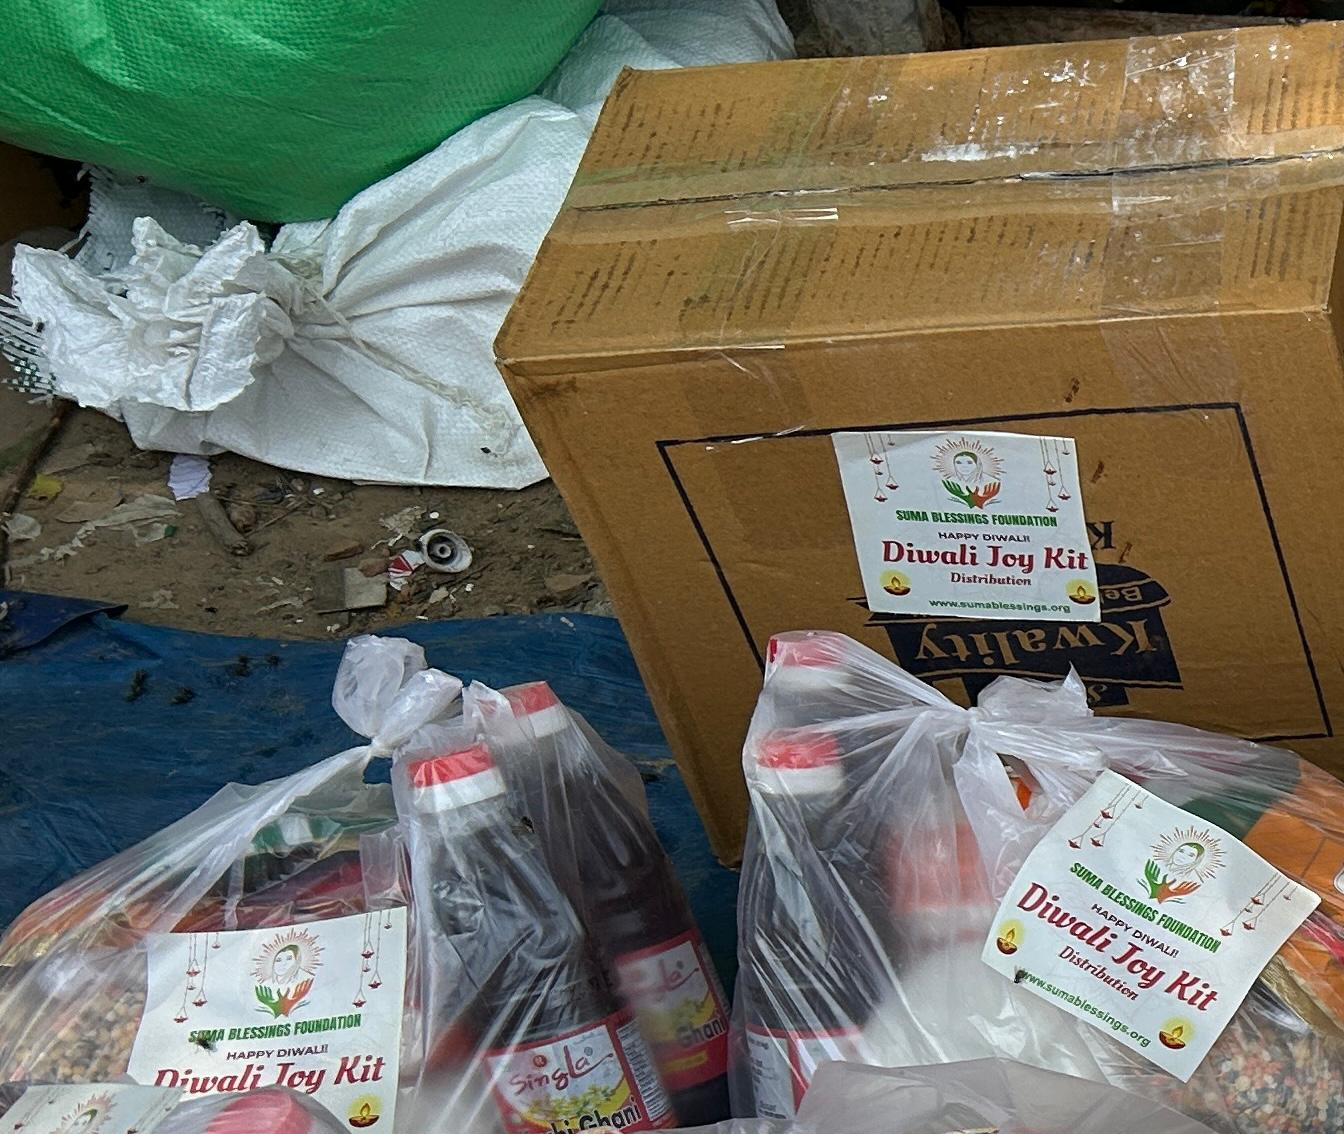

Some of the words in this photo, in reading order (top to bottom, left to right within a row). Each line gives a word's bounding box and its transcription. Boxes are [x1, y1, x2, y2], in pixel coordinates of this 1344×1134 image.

[896, 510, 929, 522] SUMA
[931, 512, 989, 525] BLESSINGS
[991, 514, 1057, 527] FOUNDATION
[882, 540, 979, 566] Diwali
[986, 545, 1034, 574] Joy
[1044, 547, 1088, 570] Kit
[951, 572, 1032, 586] Distribution
[928, 600, 1071, 614] www.sumablessings.org
[916, 619, 1156, 667] Kwality
[1070, 863, 1104, 889] SUMA
[1102, 884, 1159, 922] BLESSINGS
[1156, 913, 1222, 953] FOUNDATION
[1015, 880, 1118, 953] Diwali
[1111, 941, 1165, 989] Joy
[1165, 970, 1218, 1011] Kit
[1058, 945, 1138, 1000] Distribution
[229, 1023, 291, 1041] BLESSINGS
[293, 1014, 362, 1035] FOUNDATION
[273, 1063, 327, 1094] Joy
[334, 1055, 386, 1085] Kit
